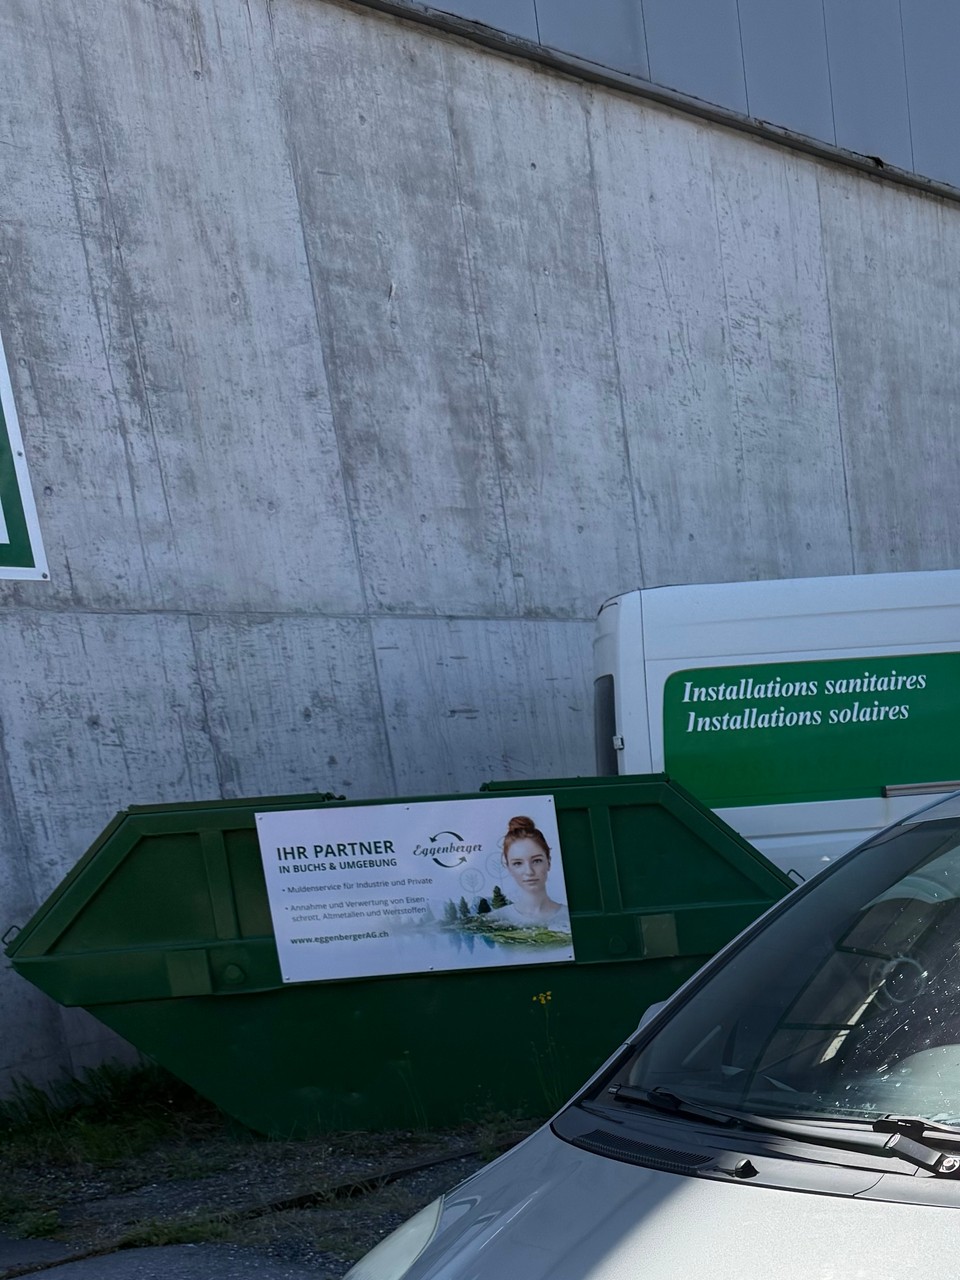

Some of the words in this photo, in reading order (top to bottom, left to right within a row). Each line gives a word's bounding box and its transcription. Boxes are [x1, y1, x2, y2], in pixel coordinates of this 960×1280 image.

[682, 677, 818, 703] Installations
[825, 670, 927, 695] sanitaires
[686, 706, 822, 732] Installations
[828, 700, 910, 725] solaires
[277, 846, 309, 861] IHR
[313, 840, 396, 859] PARTNER
[412, 842, 484, 857] Eggenberger
[279, 865, 291, 874] IN
[293, 862, 327, 873] BUCHS
[329, 862, 337, 871] &
[339, 858, 398, 870] UMGEBUNG
[287, 884, 342, 894] Muldenservice
[343, 882, 354, 891] für
[356, 880, 390, 889] Industrie
[391, 879, 406, 887] und
[407, 877, 433, 886] Private
[290, 903, 327, 912] Annahme
[329, 901, 344, 909] und
[345, 898, 389, 908] Verwertung
[405, 896, 425, 904] Eisen
[366, 909, 381, 917] und
[383, 906, 427, 916] Wertstoffen
[290, 930, 390, 945] www.eggenbergerAG.ch
